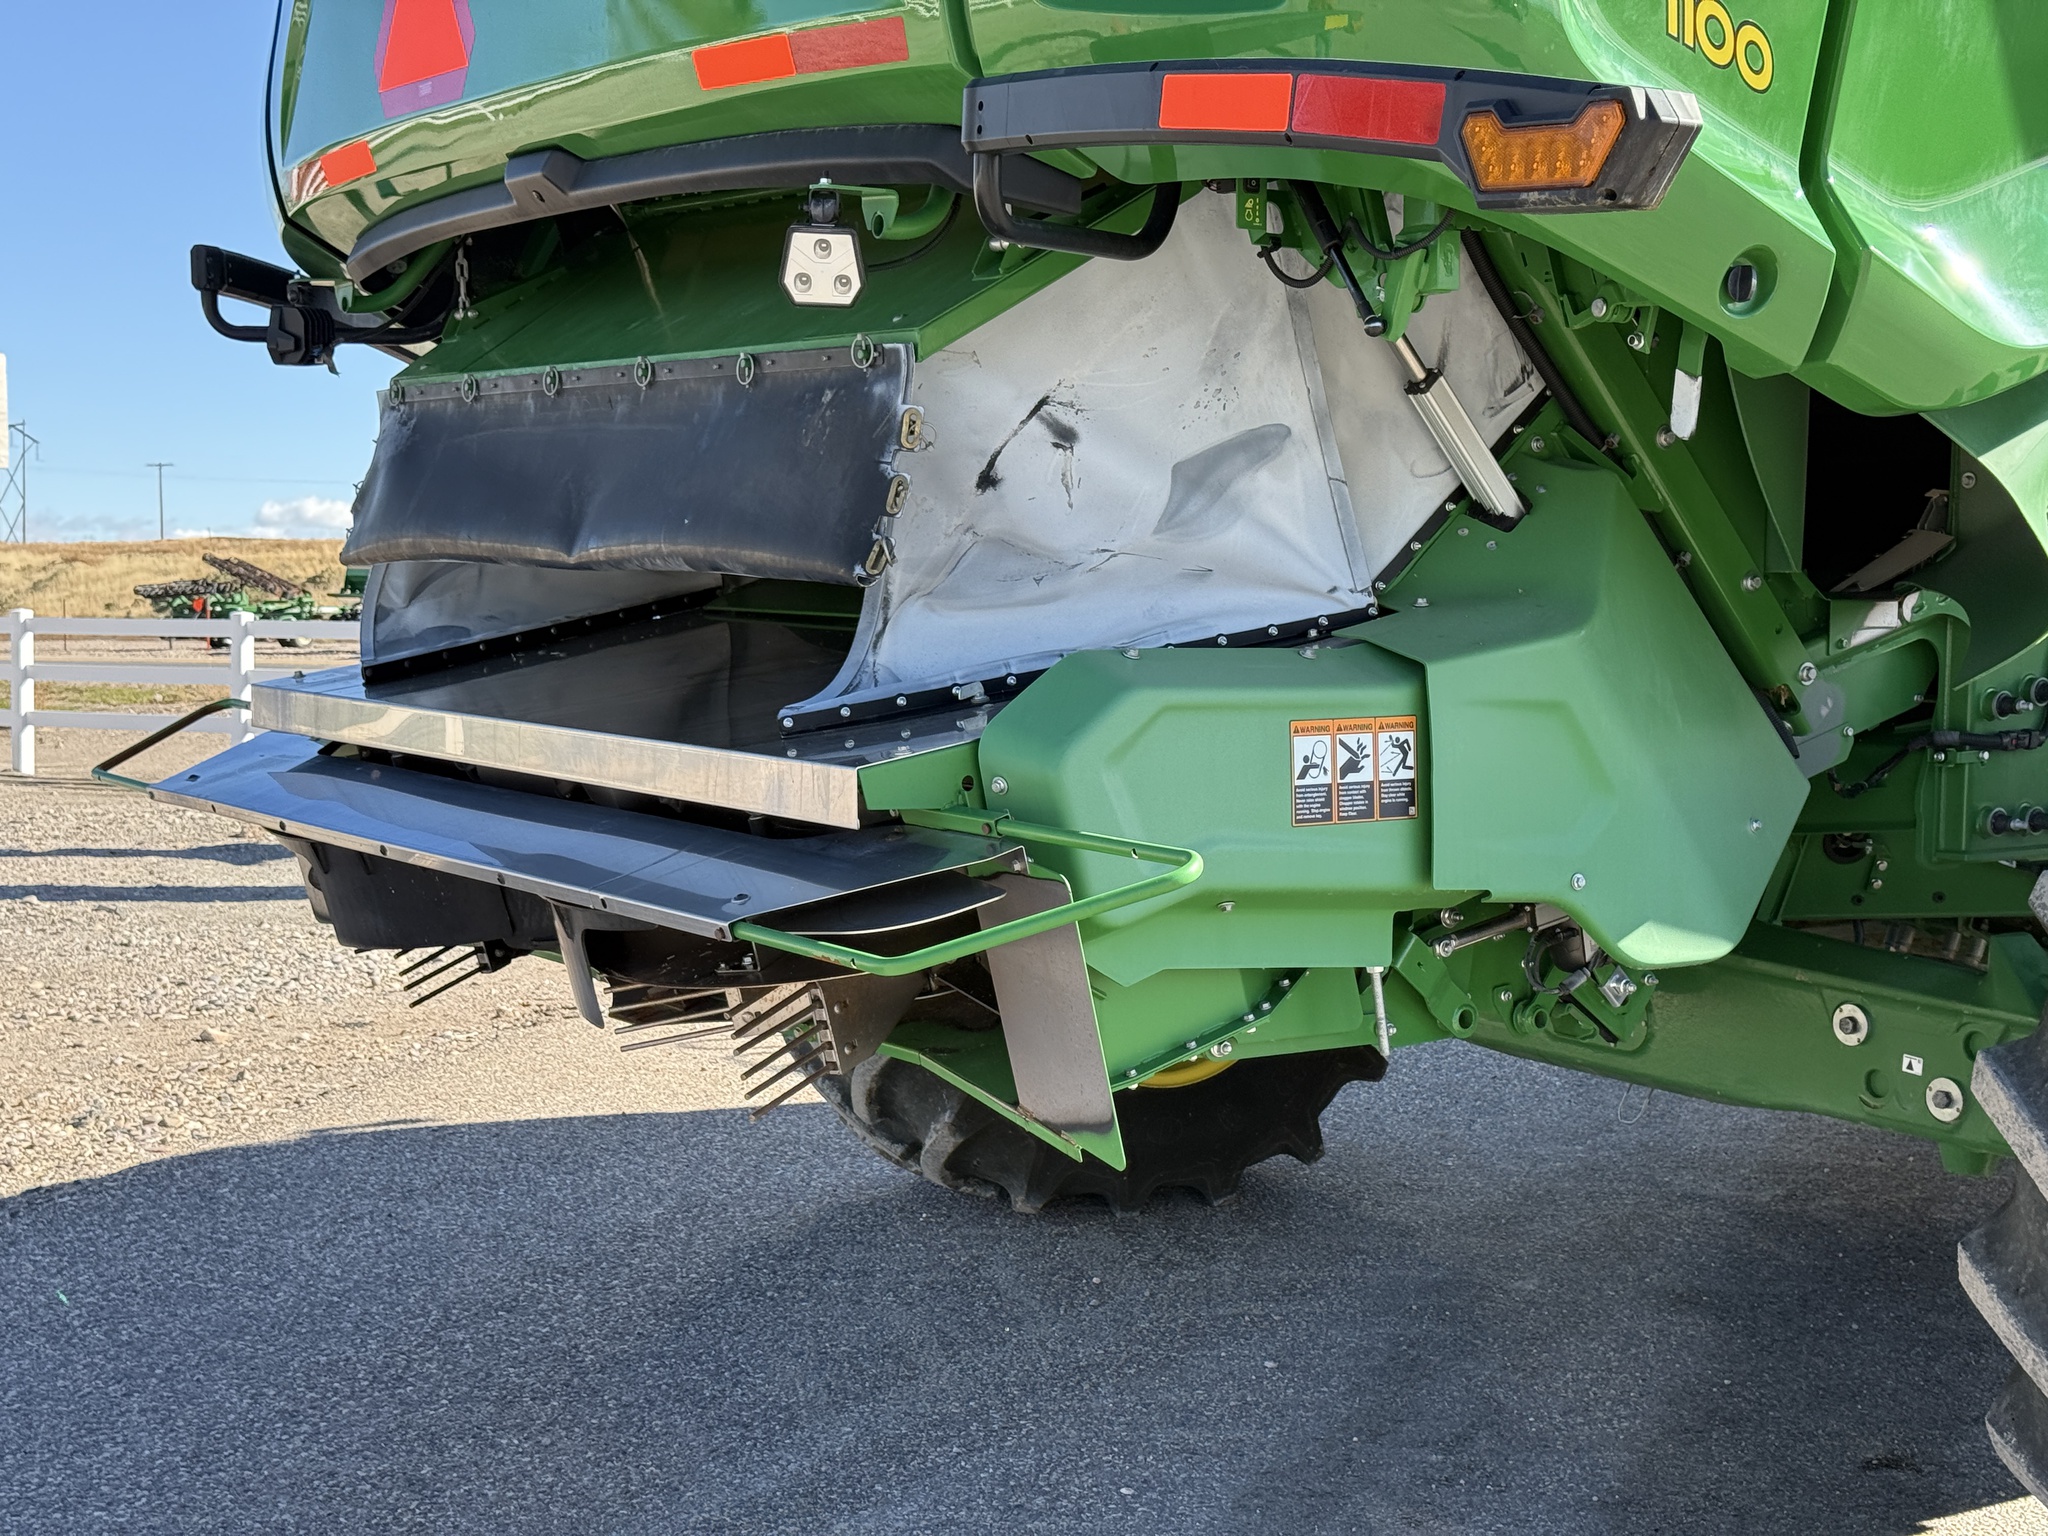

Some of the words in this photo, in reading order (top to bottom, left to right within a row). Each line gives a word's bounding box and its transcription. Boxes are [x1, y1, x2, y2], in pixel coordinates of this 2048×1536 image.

[1666, 0, 1774, 94] 1100
[1300, 725, 1331, 733] WARNING
[1342, 723, 1373, 731] WARNING
[1385, 721, 1414, 729] WARNING
